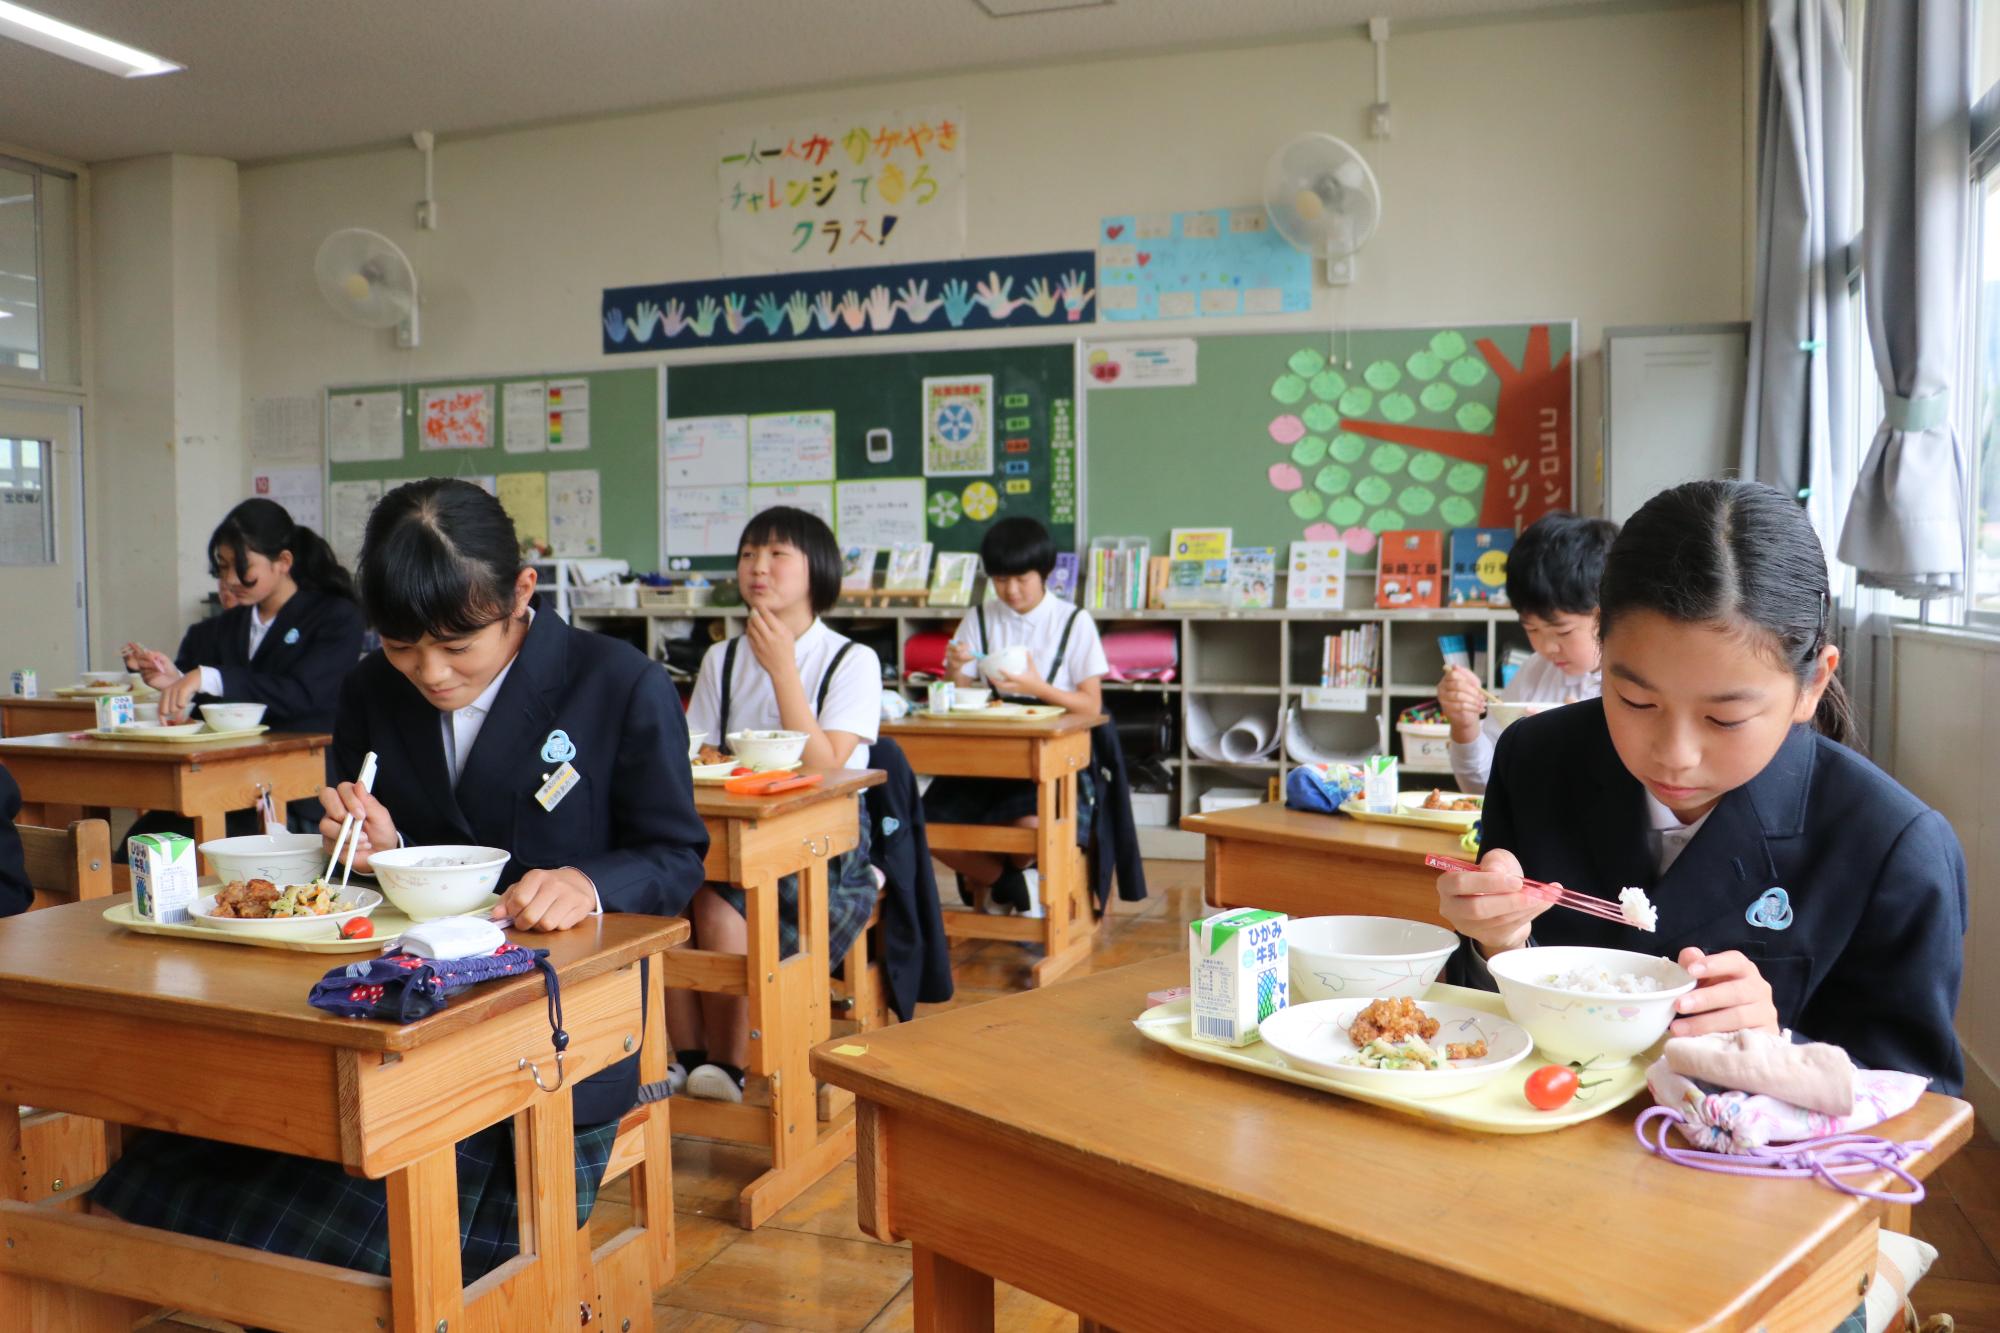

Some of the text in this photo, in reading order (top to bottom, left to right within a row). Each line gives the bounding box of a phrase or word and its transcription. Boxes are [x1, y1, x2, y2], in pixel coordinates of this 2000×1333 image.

[731, 169, 838, 213] チャレンジ
[1539, 407, 1562, 504] ココロン
[1248, 920, 1282, 947] ひかみ
[1256, 942, 1278, 965] 牛乳
